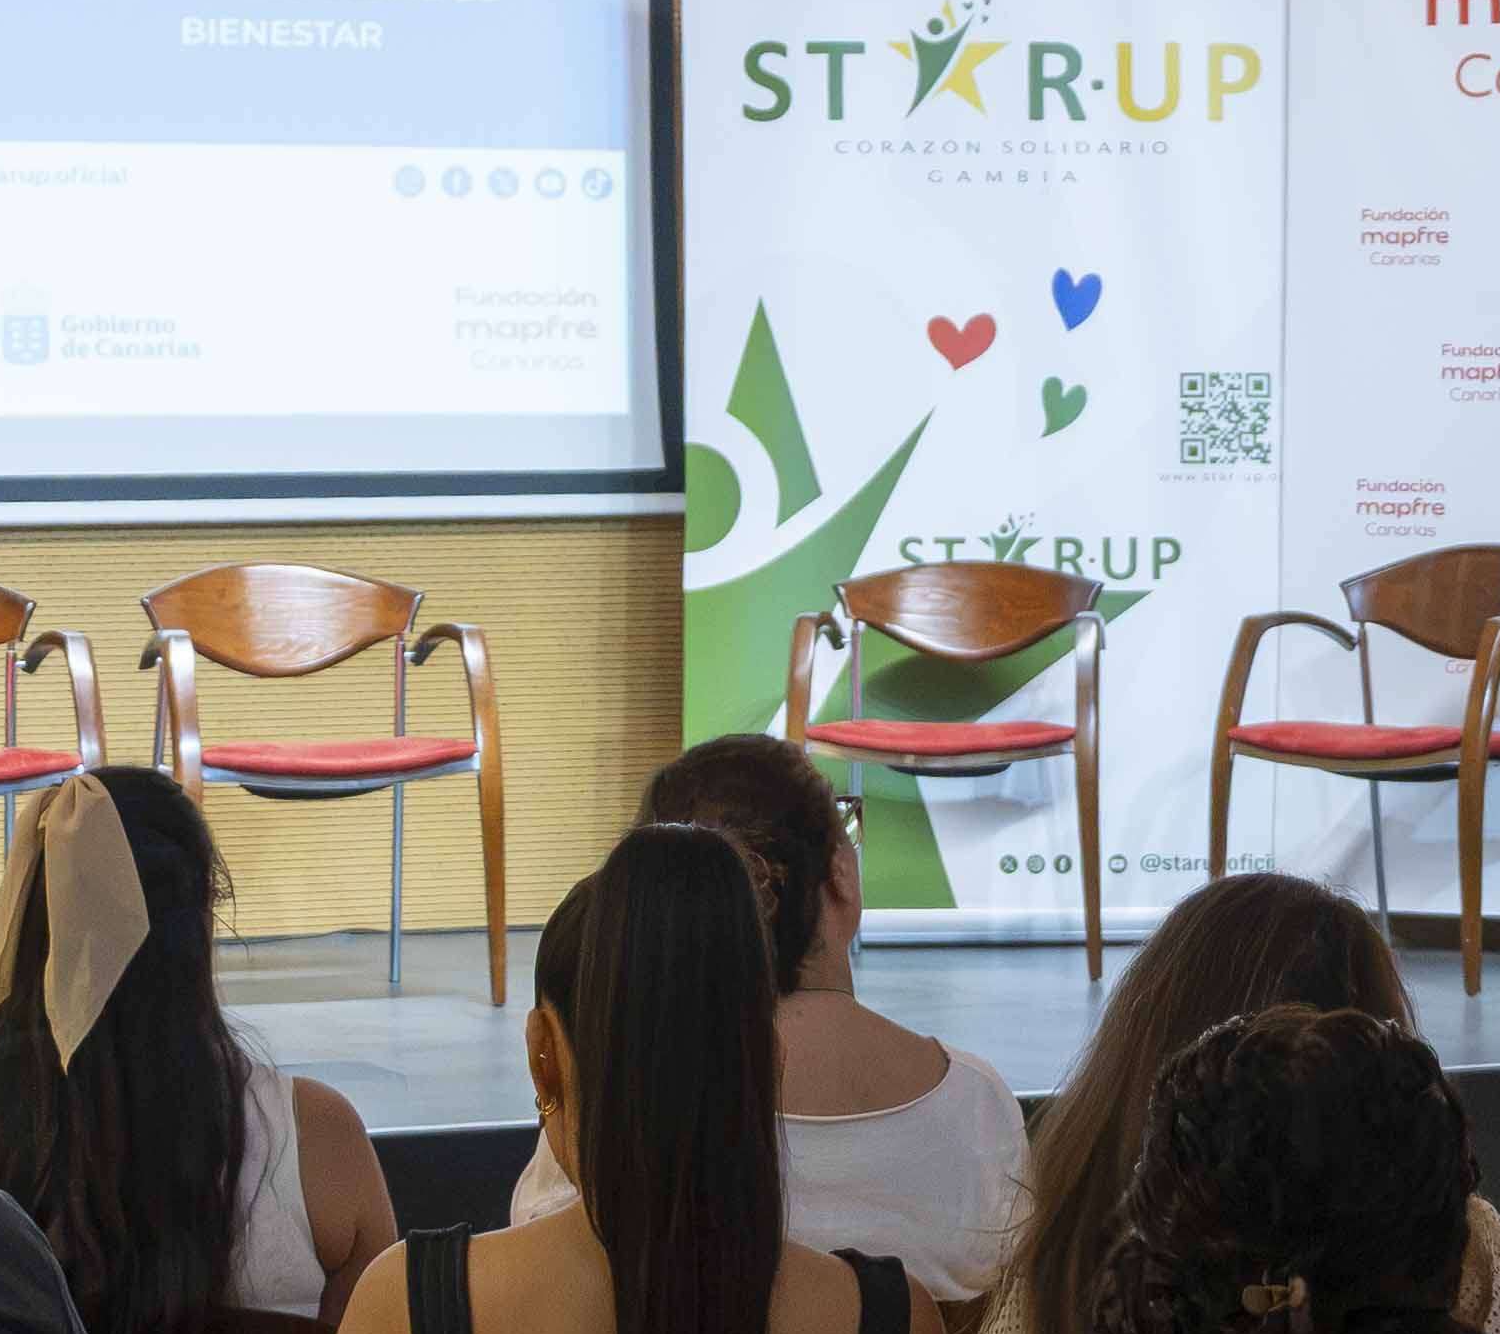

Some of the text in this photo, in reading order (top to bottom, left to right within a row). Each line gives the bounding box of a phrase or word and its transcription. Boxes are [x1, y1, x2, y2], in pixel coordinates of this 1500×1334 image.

[181, 17, 383, 50] BIENESTAR
[834, 136, 1170, 155] CORAZÓN SOLIDARIO
[927, 169, 1080, 183] GAMBIA
[1360, 206, 1450, 222] Fundación
[1360, 226, 1449, 248] mapfre
[1369, 251, 1441, 266] Canarias
[60, 313, 176, 335] Gobierno
[453, 313, 597, 344] mapfre
[61, 338, 202, 360] de Canarias
[1355, 477, 1445, 493] Fundación
[1355, 496, 1445, 519] mapfre
[1364, 522, 1437, 537] Canarias
